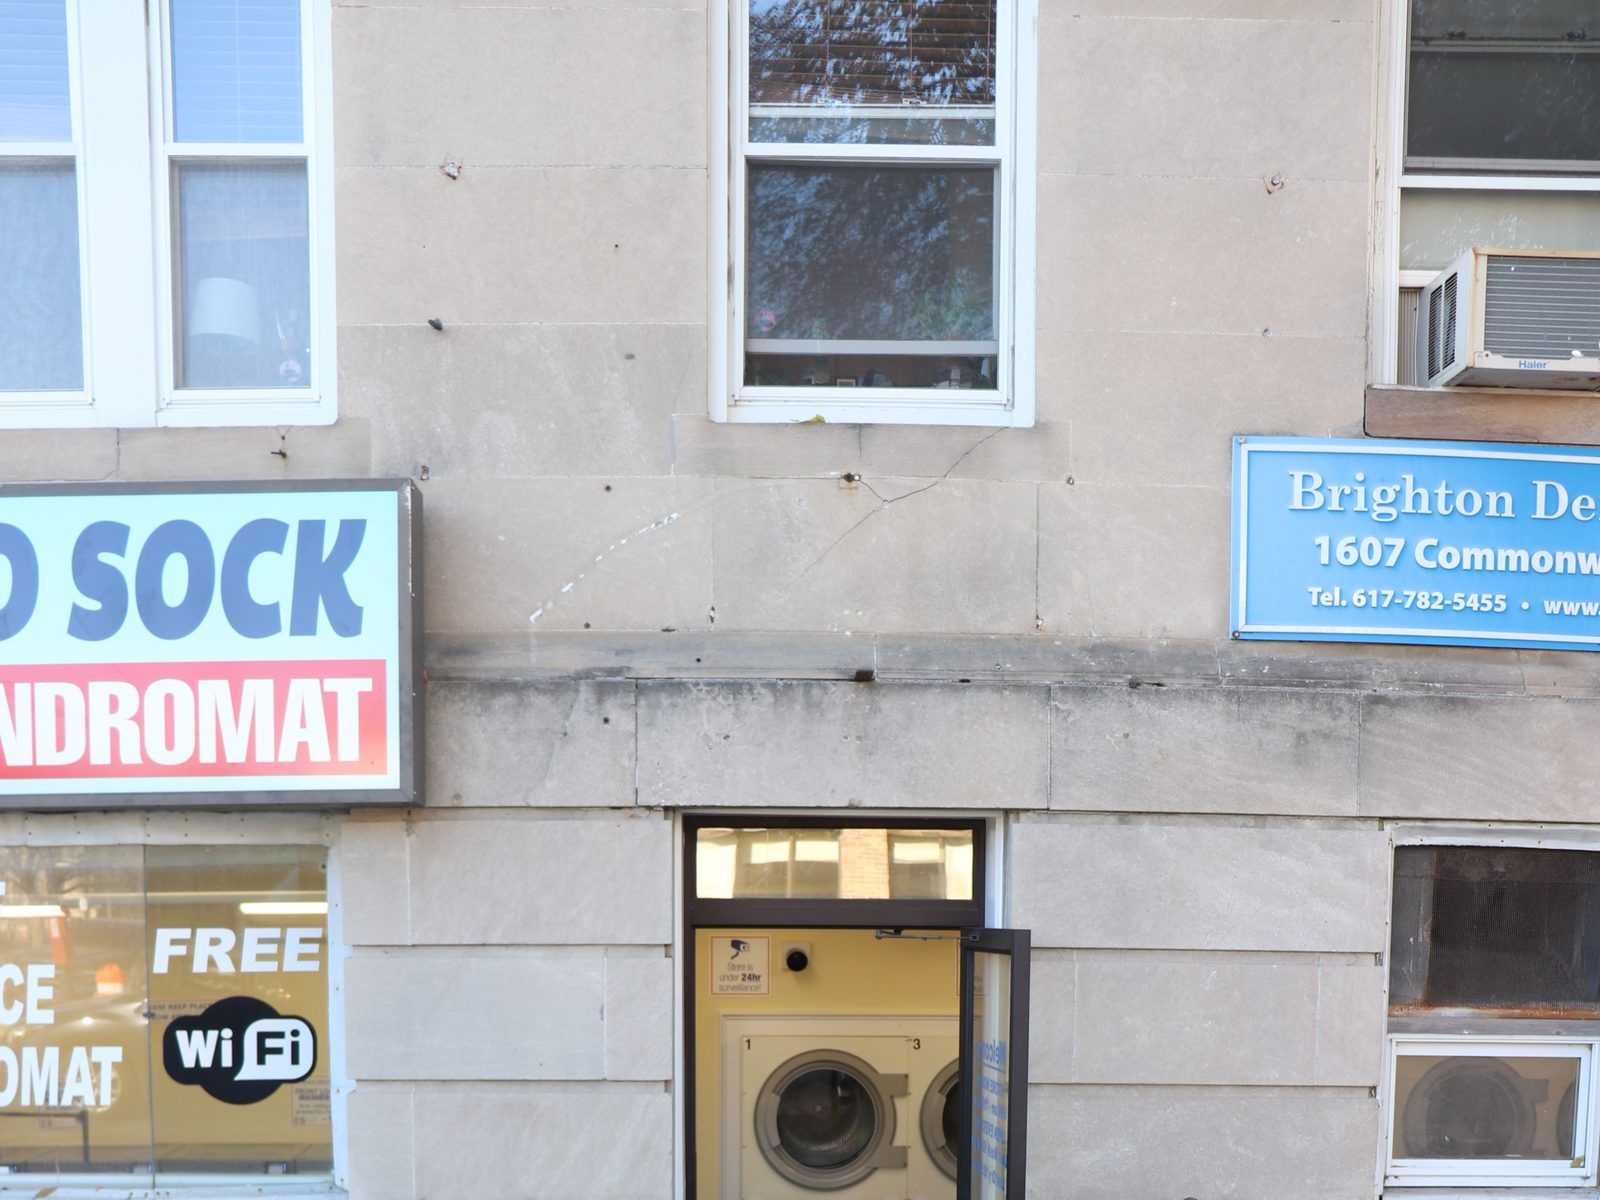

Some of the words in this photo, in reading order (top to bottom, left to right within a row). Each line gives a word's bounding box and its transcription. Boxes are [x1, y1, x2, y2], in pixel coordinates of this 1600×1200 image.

[1518, 360, 1548, 369] Haier
[1288, 470, 1515, 523] Brighton
[1531, 481, 1600, 521] De
[1314, 535, 1405, 567] 1607
[66, 517, 368, 642] SOCK
[1307, 586, 1347, 607] Tel.
[1351, 588, 1506, 612] 617-782-5455
[152, 927, 323, 974] FREE
[719, 973, 739, 982] under
[741, 972, 762, 982] 24hr
[727, 962, 746, 971] Store
[913, 1038, 921, 1050] 3
